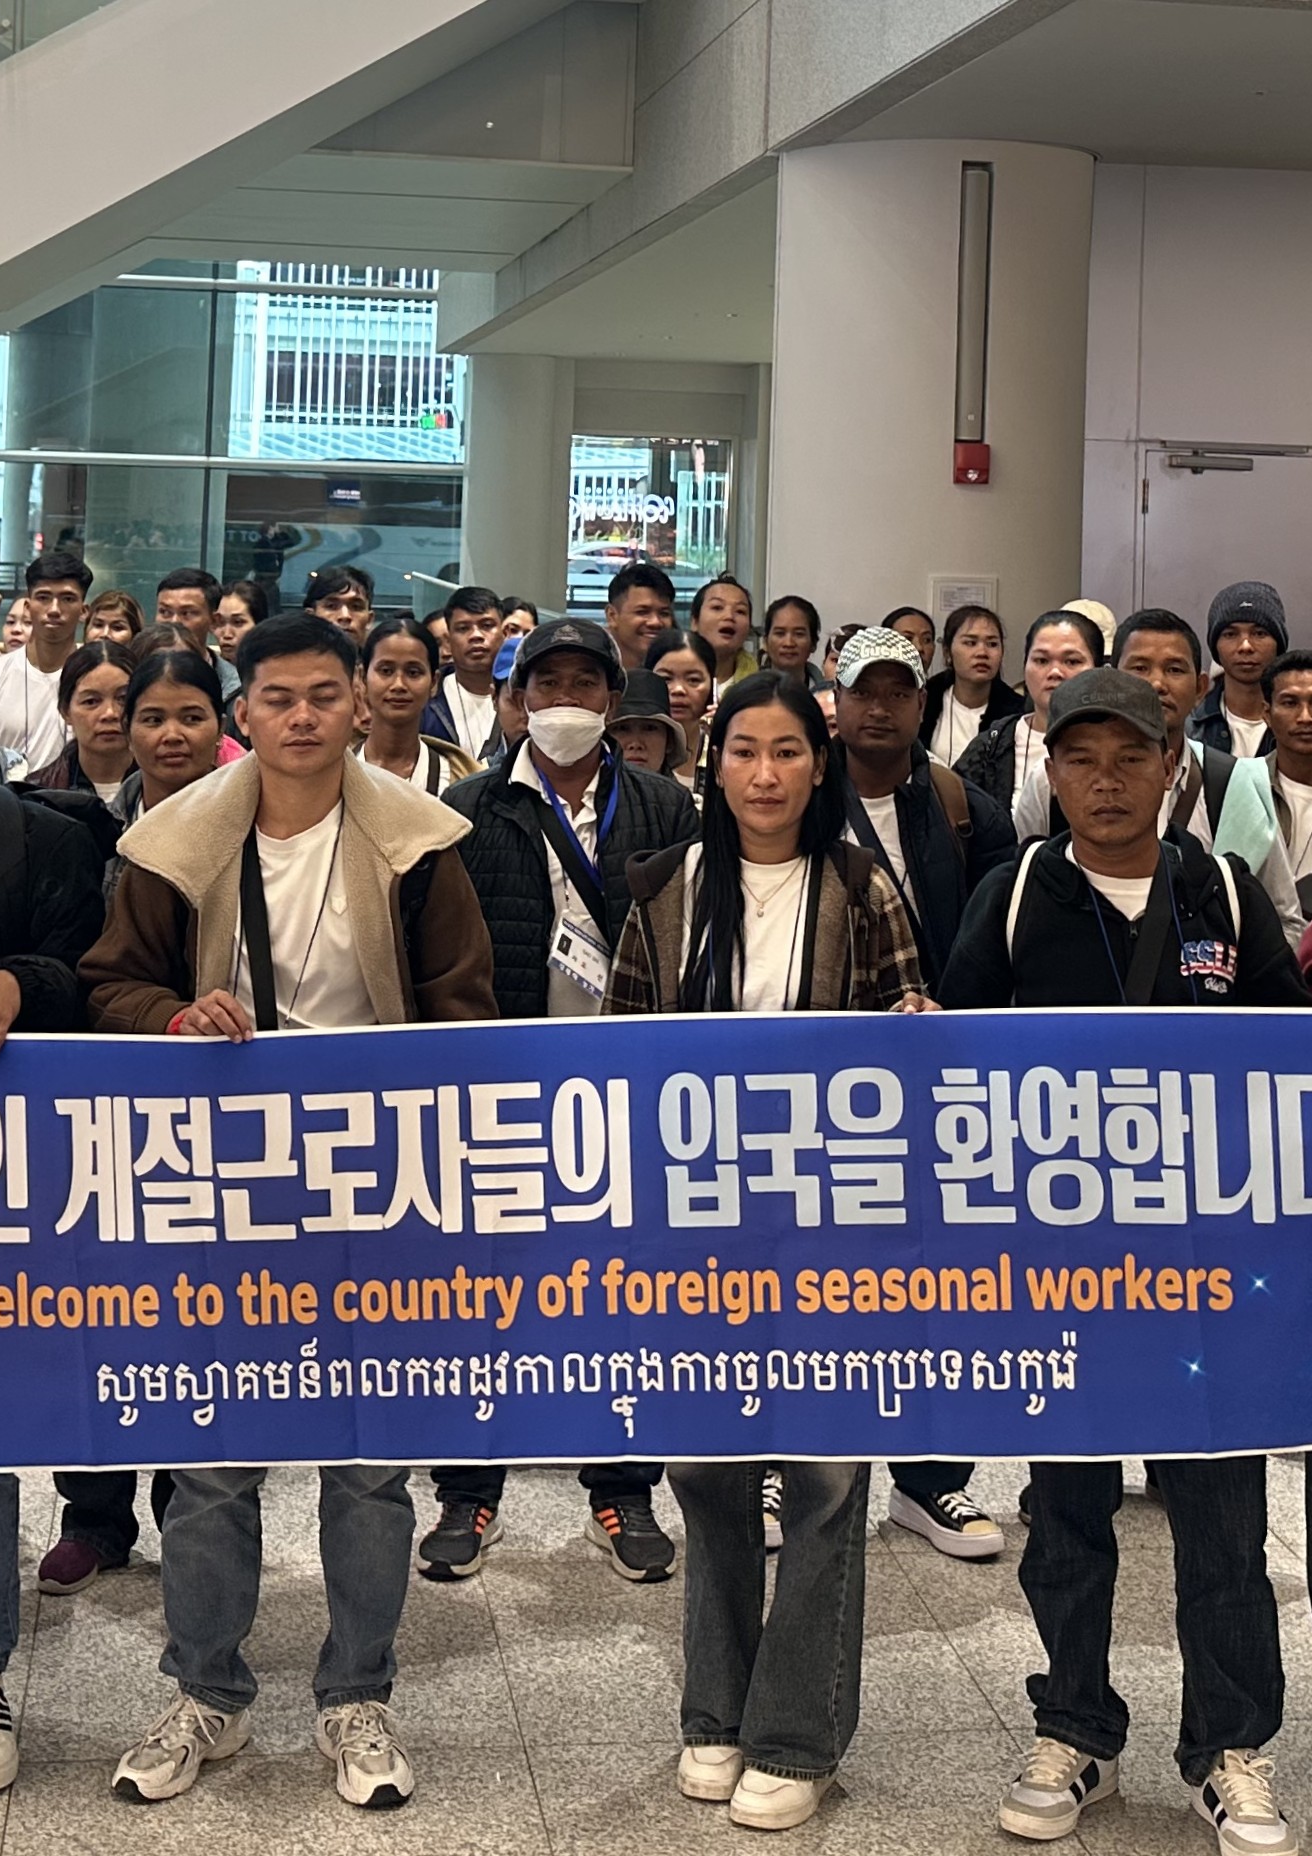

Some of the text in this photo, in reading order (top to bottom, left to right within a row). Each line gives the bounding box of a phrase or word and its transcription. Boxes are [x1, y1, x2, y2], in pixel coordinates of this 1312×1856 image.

[54, 1077, 633, 1244] 계절근로자들의
[659, 1068, 908, 1228] 입국을
[173, 1274, 224, 1327] to
[237, 1270, 318, 1326] the
[334, 1266, 523, 1330] country
[537, 1259, 589, 1317] of
[601, 1257, 781, 1325] foreign
[796, 1253, 1012, 1313] seasonal
[1026, 1254, 1233, 1312] workers
